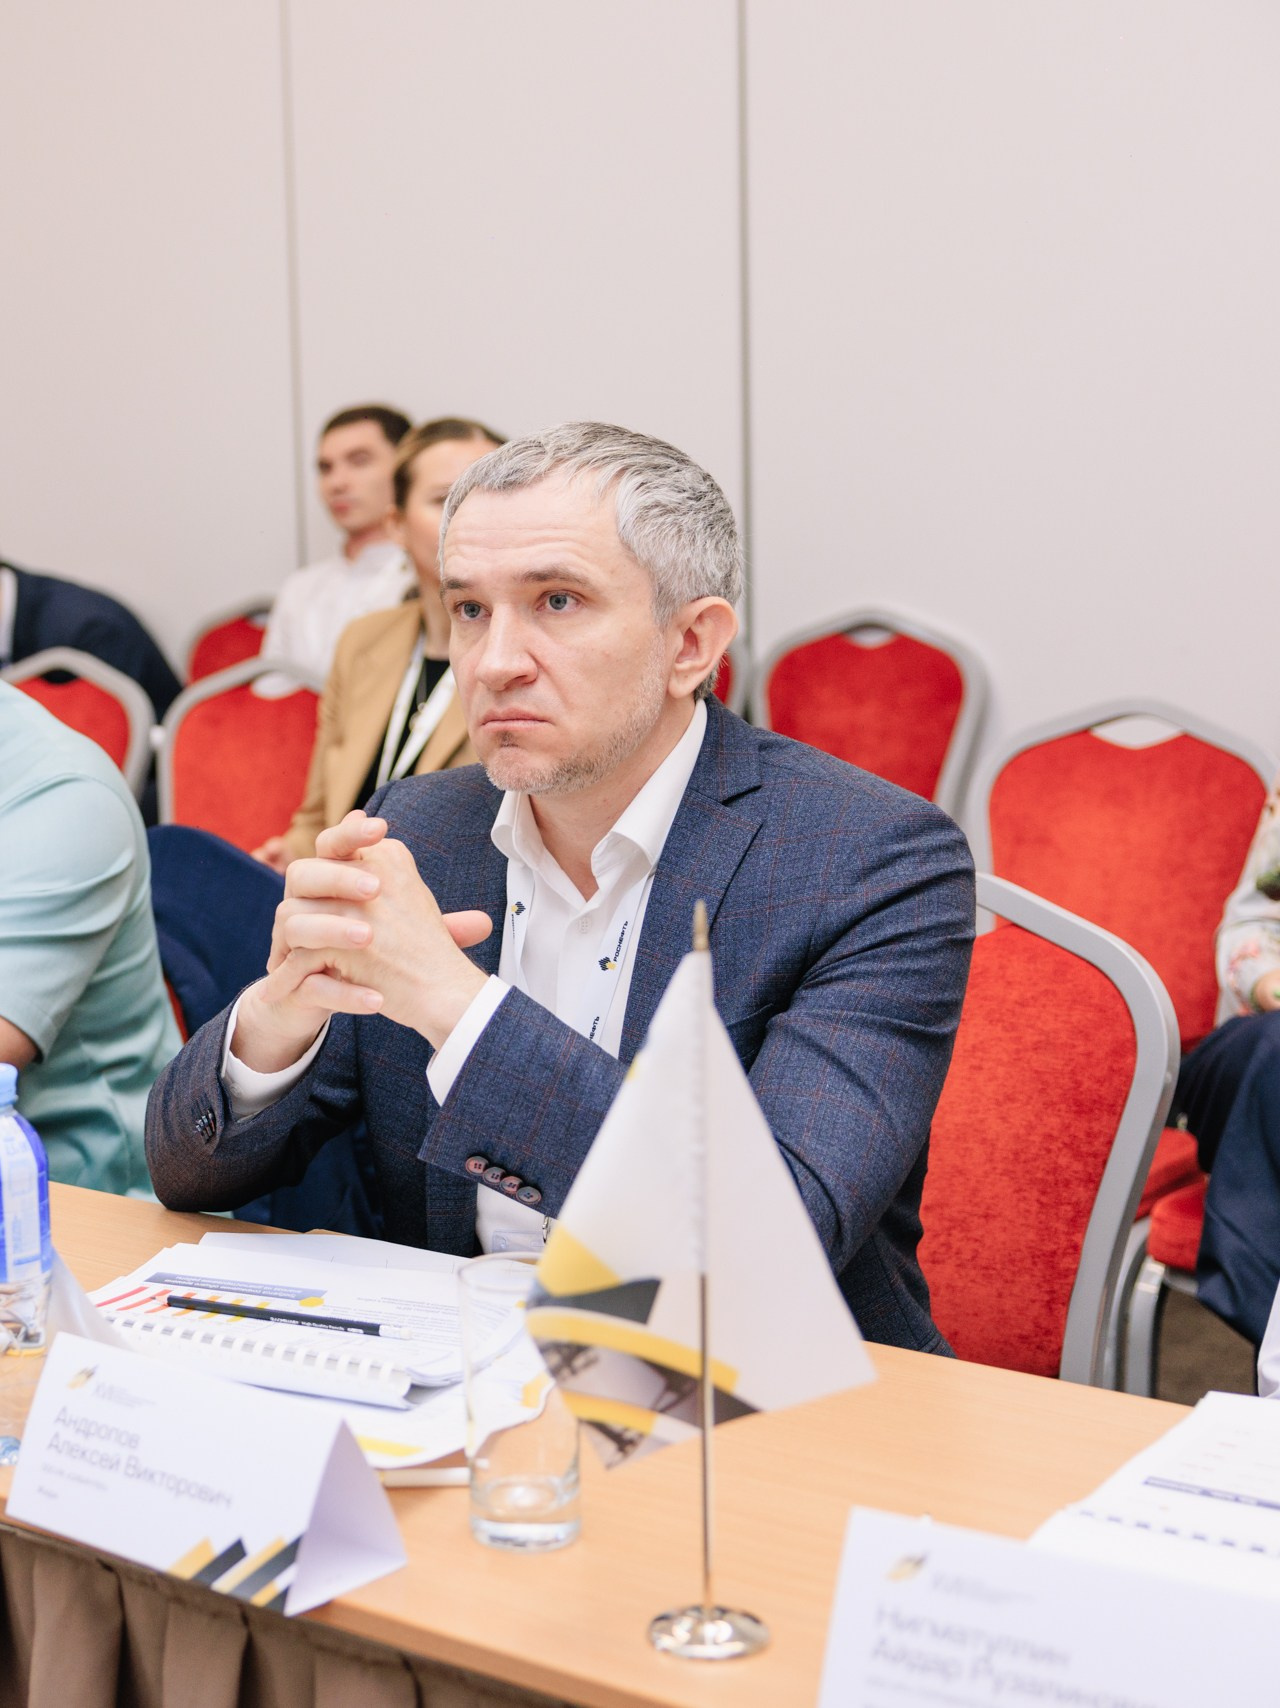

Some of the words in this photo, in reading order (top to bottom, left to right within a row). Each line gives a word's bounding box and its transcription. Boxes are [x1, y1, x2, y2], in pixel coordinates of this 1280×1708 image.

[613, 920, 629, 962] РОСНЕФТЬ
[53, 1405, 141, 1449] Андропов
[46, 1431, 120, 1472] Алексей
[123, 1455, 233, 1508] Викторович
